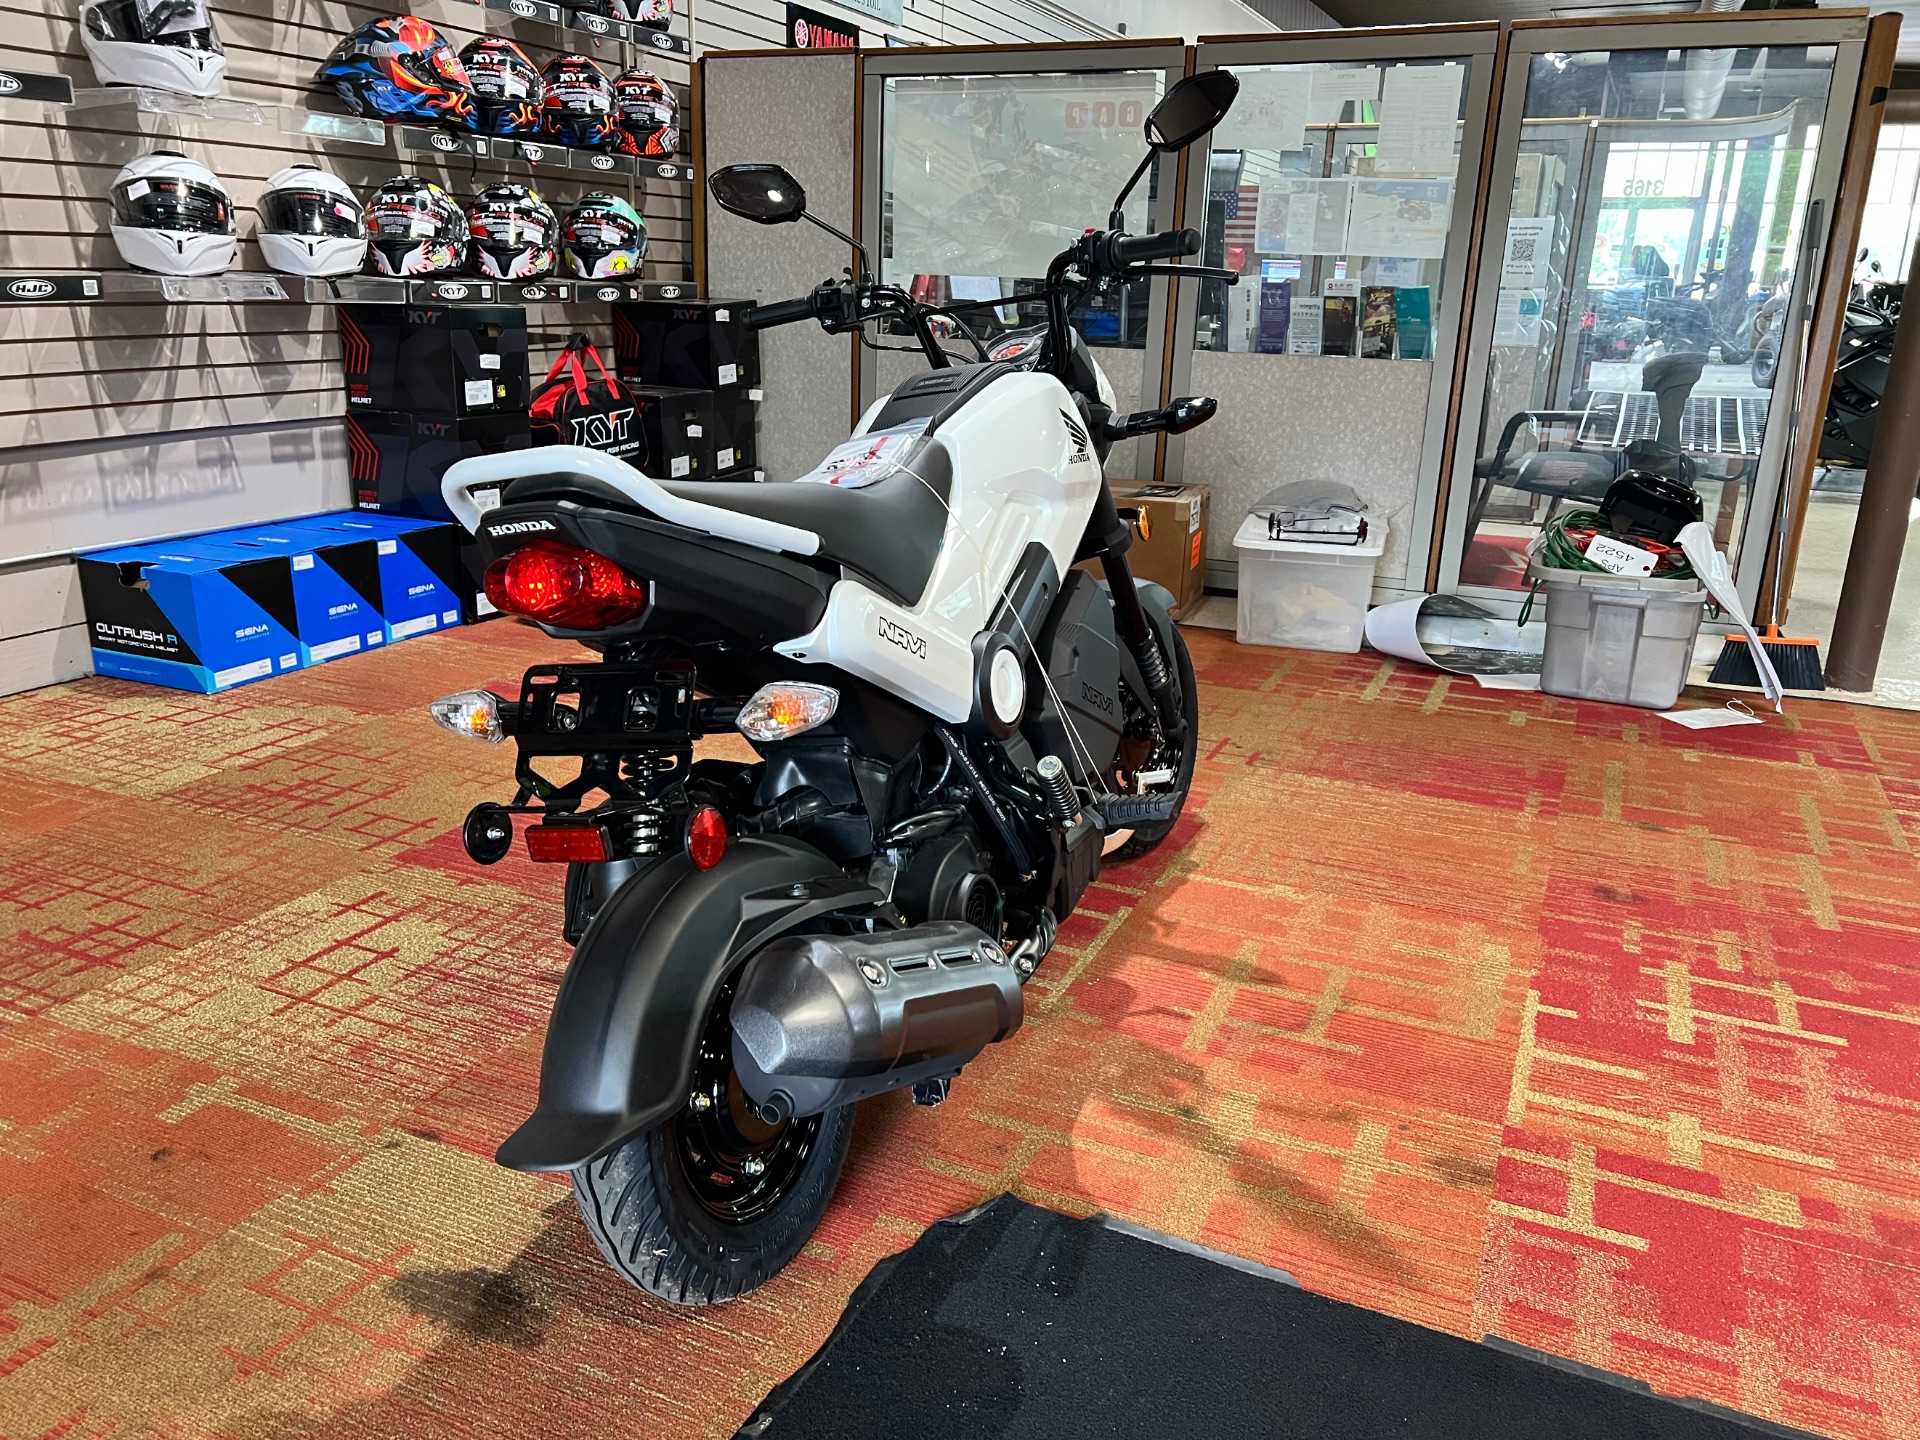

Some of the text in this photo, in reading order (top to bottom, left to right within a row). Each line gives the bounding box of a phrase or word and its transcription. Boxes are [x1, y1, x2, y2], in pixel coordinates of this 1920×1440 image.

[512, 3, 533, 14] KYT
[587, 18, 606, 30] KYT
[654, 35, 672, 47] KYT
[809, 24, 854, 47] YAMAHA
[473, 54, 512, 64] KYT
[559, 73, 588, 82] KYT
[625, 85, 652, 94] KYT
[593, 157, 612, 168] KYT
[659, 166, 676, 176] KYT
[382, 194, 416, 203] KYT
[489, 203, 521, 212] KYT
[580, 209, 607, 218] KYT
[15, 284, 49, 293] HJC
[440, 286, 465, 298] KYT
[600, 290, 617, 299] KYT
[662, 287, 679, 297] KYT
[408, 310, 443, 324] KYT
[674, 308, 702, 320] KYT
[351, 396, 373, 404] HELMET
[417, 422, 451, 436] KYT
[571, 407, 635, 447] KYT
[620, 441, 640, 452] RACING
[1068, 452, 1091, 465] HONDA
[359, 502, 381, 510] HELMET
[488, 520, 556, 537] HONDA
[1595, 542, 1635, 561] 4522
[1601, 559, 1624, 573] APS
[408, 583, 436, 595] SENA
[328, 602, 358, 616] SENA
[96, 622, 163, 643] OUTRUSH
[235, 624, 269, 639] SENA
[98, 635, 179, 653] SMART MOTORCYCLE HELMET
